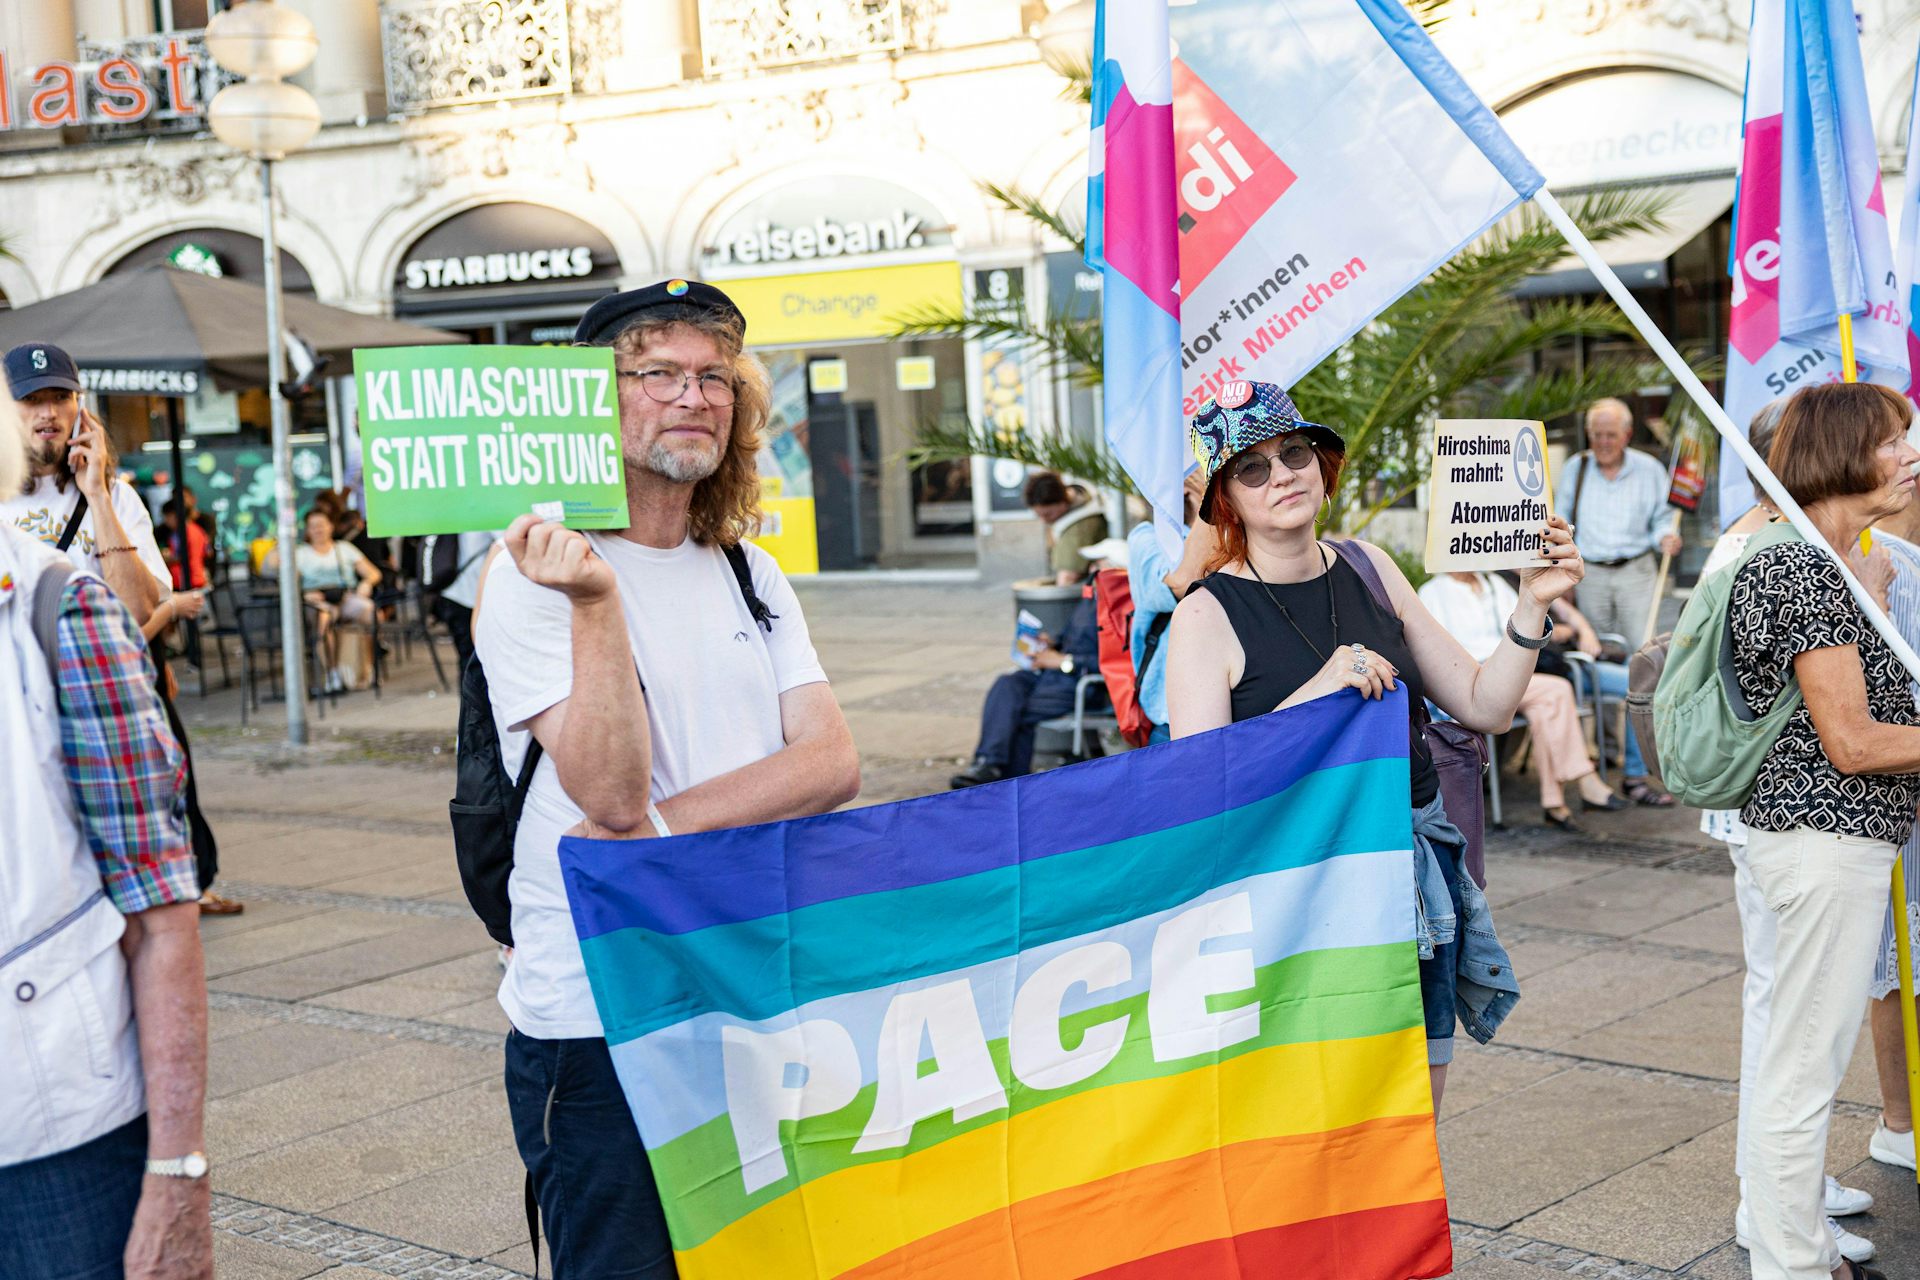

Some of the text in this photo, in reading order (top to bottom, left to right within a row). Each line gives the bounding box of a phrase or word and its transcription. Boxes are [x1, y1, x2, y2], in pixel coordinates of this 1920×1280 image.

[0, 41, 194, 128] last
[405, 247, 593, 289] STARBUCKS
[989, 270, 1009, 300] 8
[781, 291, 878, 319] Change
[1242, 256, 1368, 360] München
[78, 368, 198, 393] STARBUCKS
[365, 367, 613, 421] KLIMASCHUTZ
[1222, 382, 1247, 398] NO
[1221, 396, 1245, 404] WAR
[370, 422, 619, 492] STATT RÜSTUNG
[1437, 435, 1511, 456] Hiroshima
[1450, 462, 1504, 483] mahnt:
[1450, 498, 1547, 524] Atomwaffen
[722, 891, 1260, 1195] PACE
